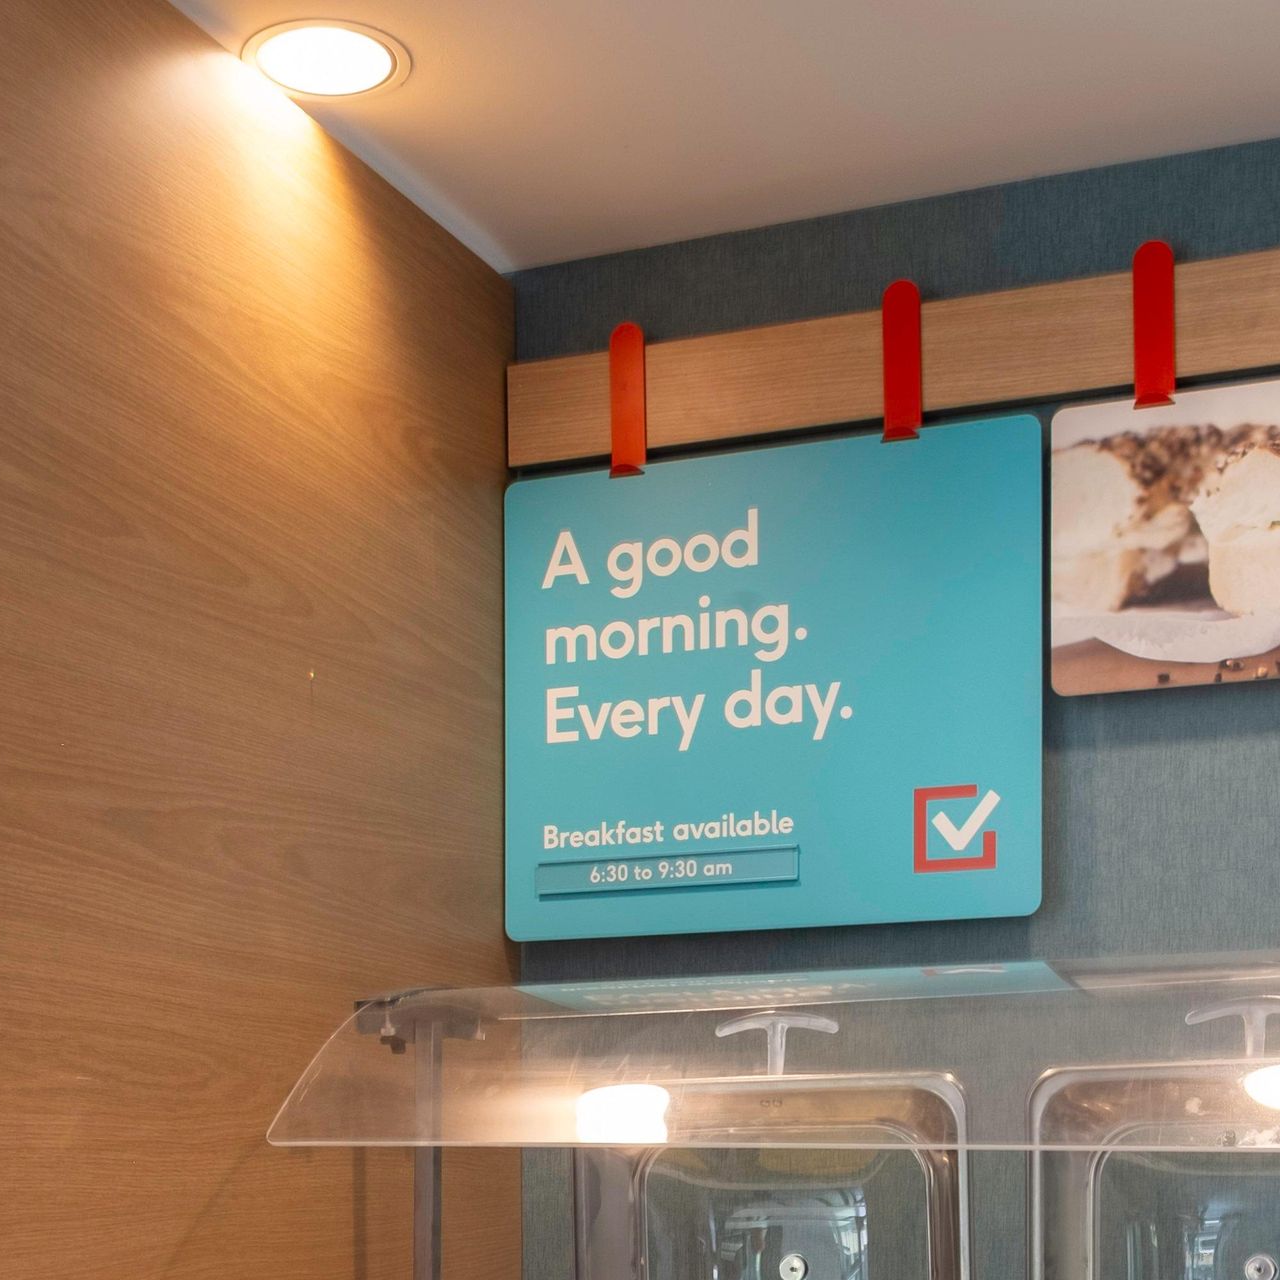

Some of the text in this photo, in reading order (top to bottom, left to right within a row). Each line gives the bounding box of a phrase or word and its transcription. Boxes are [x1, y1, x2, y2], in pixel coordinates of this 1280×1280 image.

[541, 507, 759, 599] A good
[545, 595, 807, 665] morning.
[546, 669, 854, 752] Every day.
[543, 809, 795, 849] Breakfast available
[590, 860, 733, 884] 6:30 to 9:30 am
